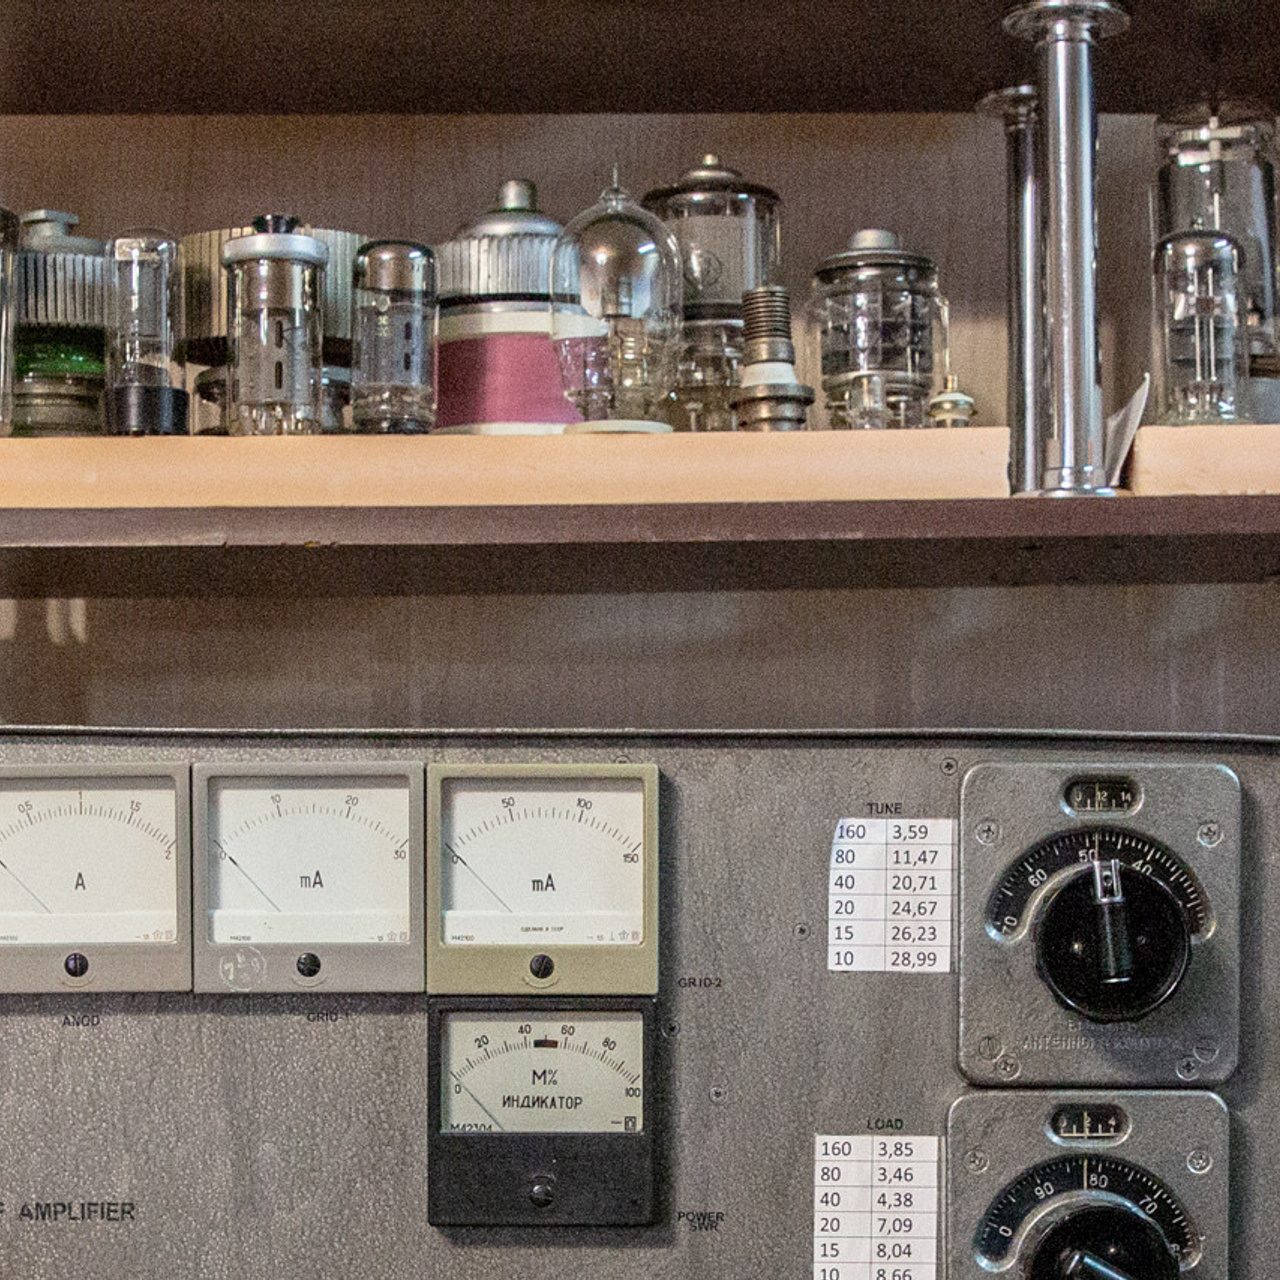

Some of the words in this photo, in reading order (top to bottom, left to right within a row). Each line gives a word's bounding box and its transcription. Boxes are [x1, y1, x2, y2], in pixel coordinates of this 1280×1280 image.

[270, 794, 282, 805] 10
[345, 795, 359, 807] 20
[501, 797, 515, 808] 50
[576, 798, 593, 811] 100
[868, 803, 902, 814] TUNE
[838, 825, 866, 839] 160
[892, 825, 929, 841] 3,59
[393, 850, 406, 861] 30
[622, 853, 640, 864] 150
[835, 849, 855, 864] 80
[893, 850, 939, 866] 11,47
[74, 872, 87, 890] A
[299, 869, 324, 889] mA
[531, 873, 556, 892] mA
[834, 875, 855, 889] 40
[892, 876, 938, 892] 20,71
[1028, 868, 1048, 888] 60
[834, 900, 855, 914] 20
[892, 901, 938, 917] 24,67
[835, 926, 854, 940] 15
[891, 926, 938, 943] 26,23
[835, 951, 854, 965] 10
[891, 952, 937, 969] 28,99
[678, 977, 722, 988] GRID-2
[518, 1025, 532, 1035] 40
[561, 1024, 575, 1036] 60
[474, 1035, 490, 1048] 20
[602, 1037, 617, 1050] 80
[625, 1087, 641, 1098] 100
[502, 1095, 583, 1109] ИНДИКАТОР
[867, 1118, 904, 1130] LOAD
[821, 1142, 852, 1156] 160
[878, 1141, 914, 1159] 3,85
[820, 1167, 841, 1181] 80
[877, 1167, 914, 1184] 3,46
[1089, 1173, 1109, 1188] 80
[1034, 1181, 1055, 1199] 90
[820, 1192, 841, 1206] 40
[877, 1192, 913, 1209] 4,38
[1138, 1196, 1158, 1214] 70
[19, 1202, 136, 1221] AMPLIFIER
[677, 1212, 725, 1222] POWER
[689, 1222, 718, 1231] SWR
[820, 1217, 840, 1232] 20
[877, 1218, 913, 1235] 7,09
[820, 1243, 840, 1257] 15
[877, 1243, 912, 1260] 8,04
